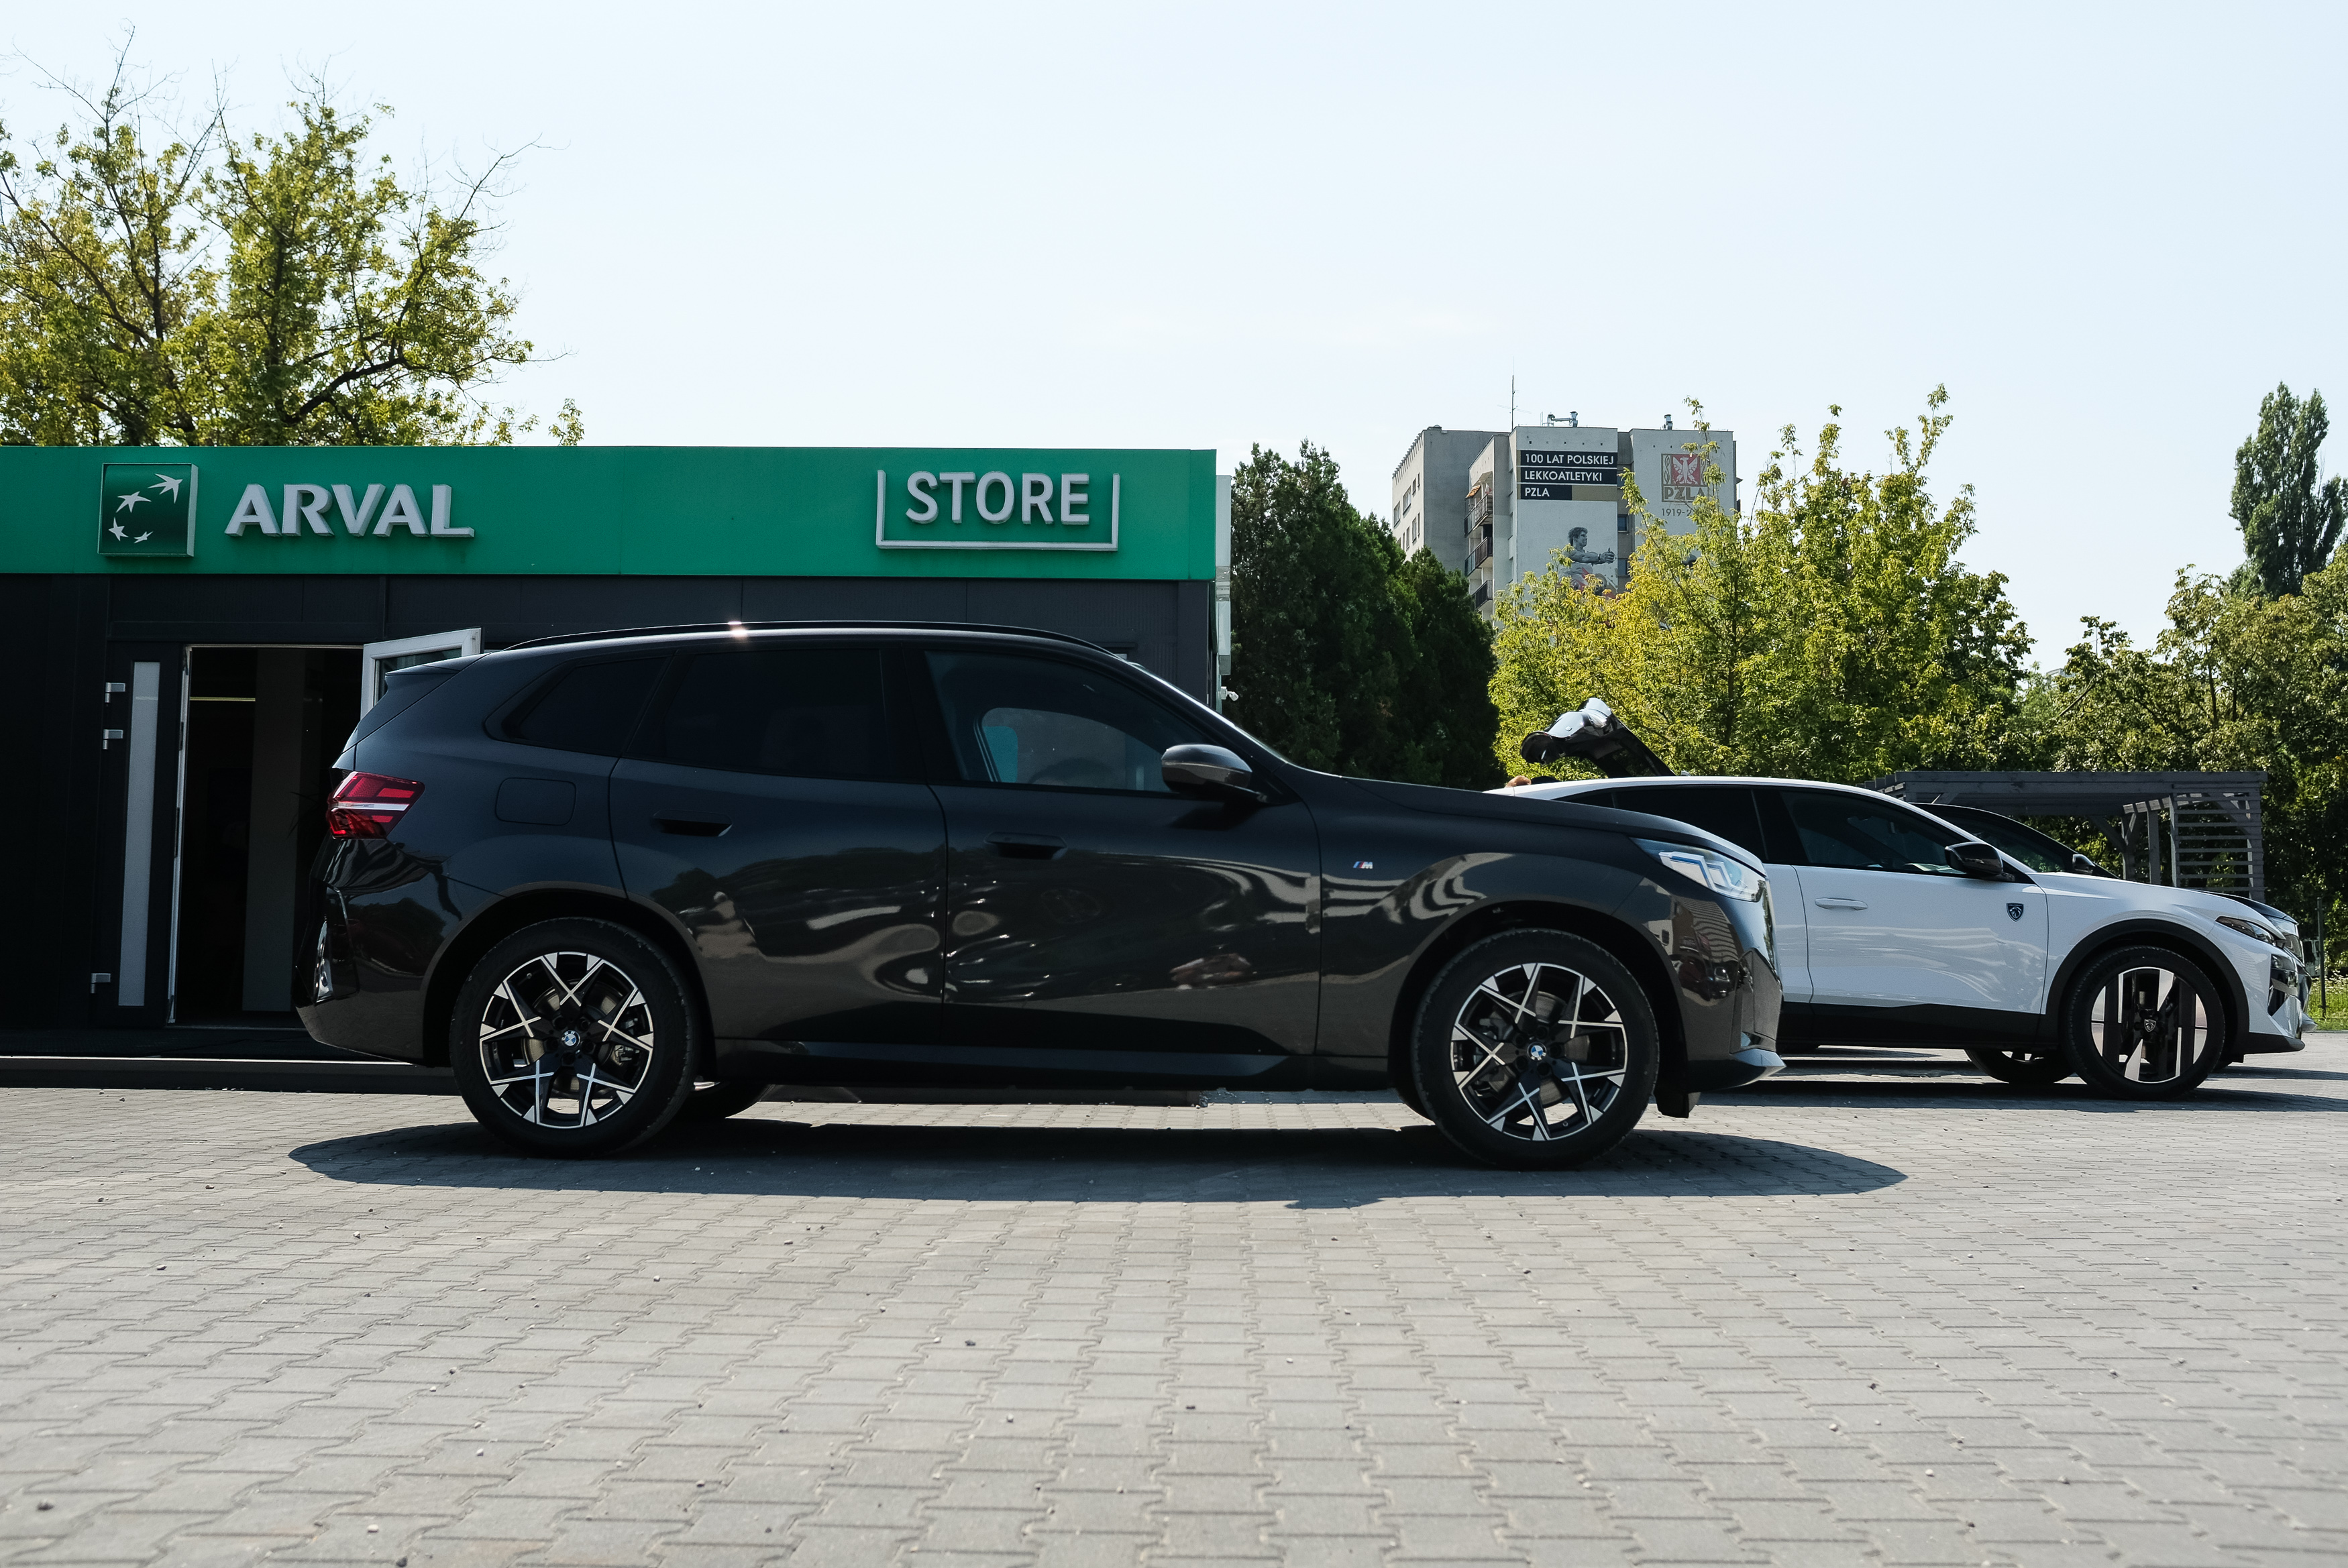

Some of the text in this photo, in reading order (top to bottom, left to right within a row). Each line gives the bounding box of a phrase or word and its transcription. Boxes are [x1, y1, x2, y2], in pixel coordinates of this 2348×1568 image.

[1526, 453, 1614, 465] 100 LAT POLSKIEJ
[1524, 470, 1602, 482] LEKKOATLETYKI
[906, 471, 1090, 525] STORE
[1524, 488, 1550, 497] PZLA
[224, 483, 475, 537] ARVAL
